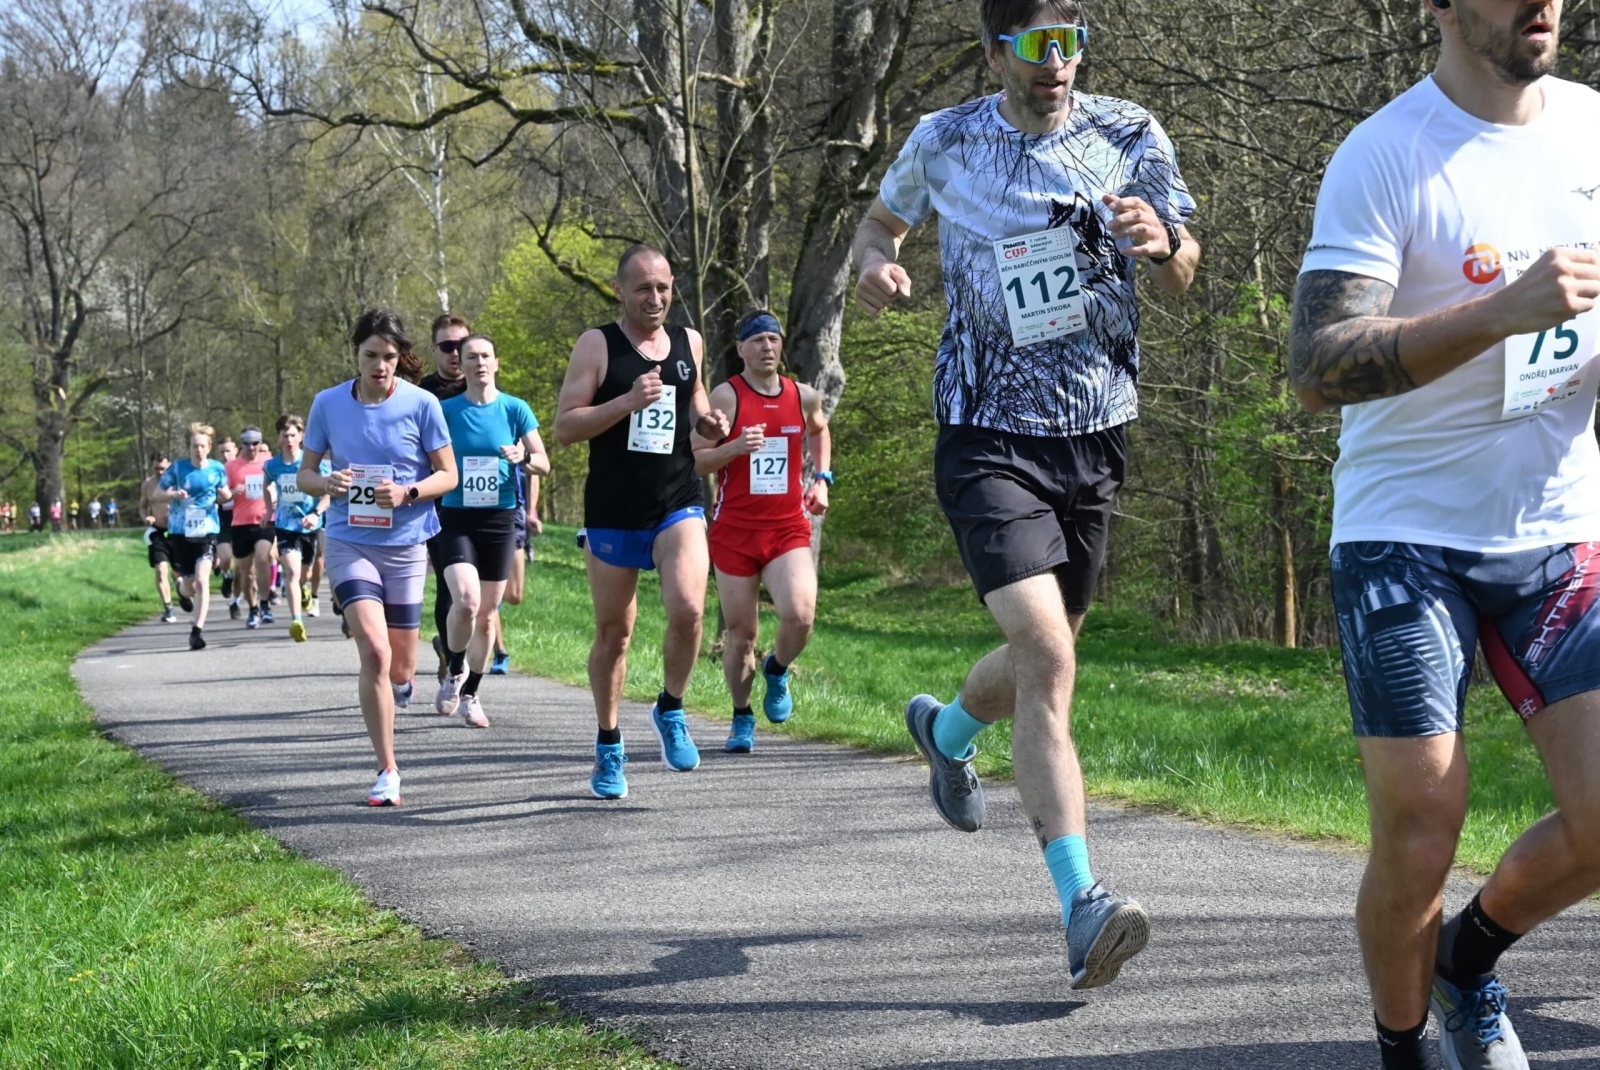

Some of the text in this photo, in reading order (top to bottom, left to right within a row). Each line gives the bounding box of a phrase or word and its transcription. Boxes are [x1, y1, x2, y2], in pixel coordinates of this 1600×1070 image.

[1001, 252, 1072, 272] BĚH BABIČČINÝM ÚDOLÍM
[1004, 247, 1028, 259] CUP
[1005, 265, 1079, 309] 112
[1021, 302, 1072, 320] MARTIN SÝKORA
[1519, 363, 1579, 381] ONDŘEJ MARVAN
[633, 408, 674, 430] 132
[752, 457, 787, 475] 127
[464, 475, 498, 491] 408
[349, 485, 376, 505] 29
